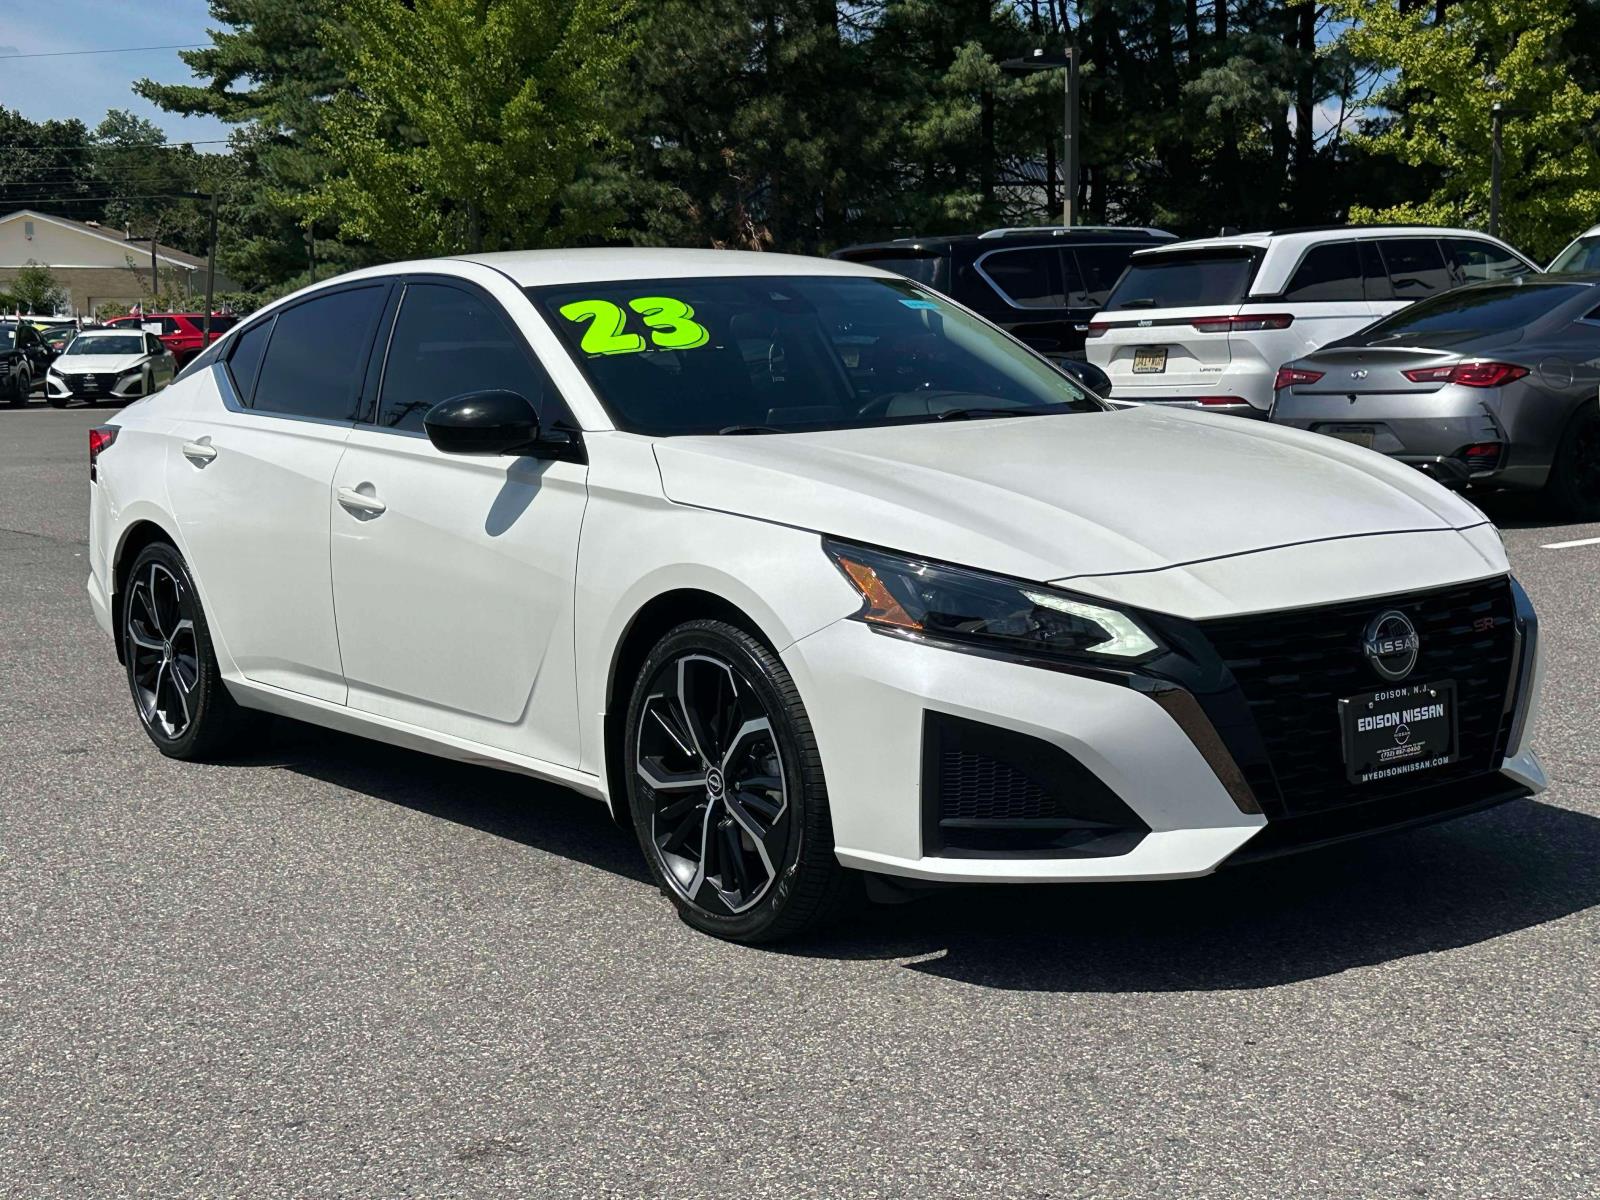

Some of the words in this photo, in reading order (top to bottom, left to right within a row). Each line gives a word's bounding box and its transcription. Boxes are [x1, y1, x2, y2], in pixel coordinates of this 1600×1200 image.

[559, 297, 710, 355] 23
[1473, 617, 1494, 632] SR
[1366, 635, 1420, 656] NISSAN
[1375, 688, 1411, 702] EDISON,
[1413, 684, 1431, 696] N.J.
[1358, 712, 1400, 732] EDISON
[1402, 703, 1444, 724] NISSAN
[1362, 756, 1449, 782] MYEDISONNISSAN.COM
